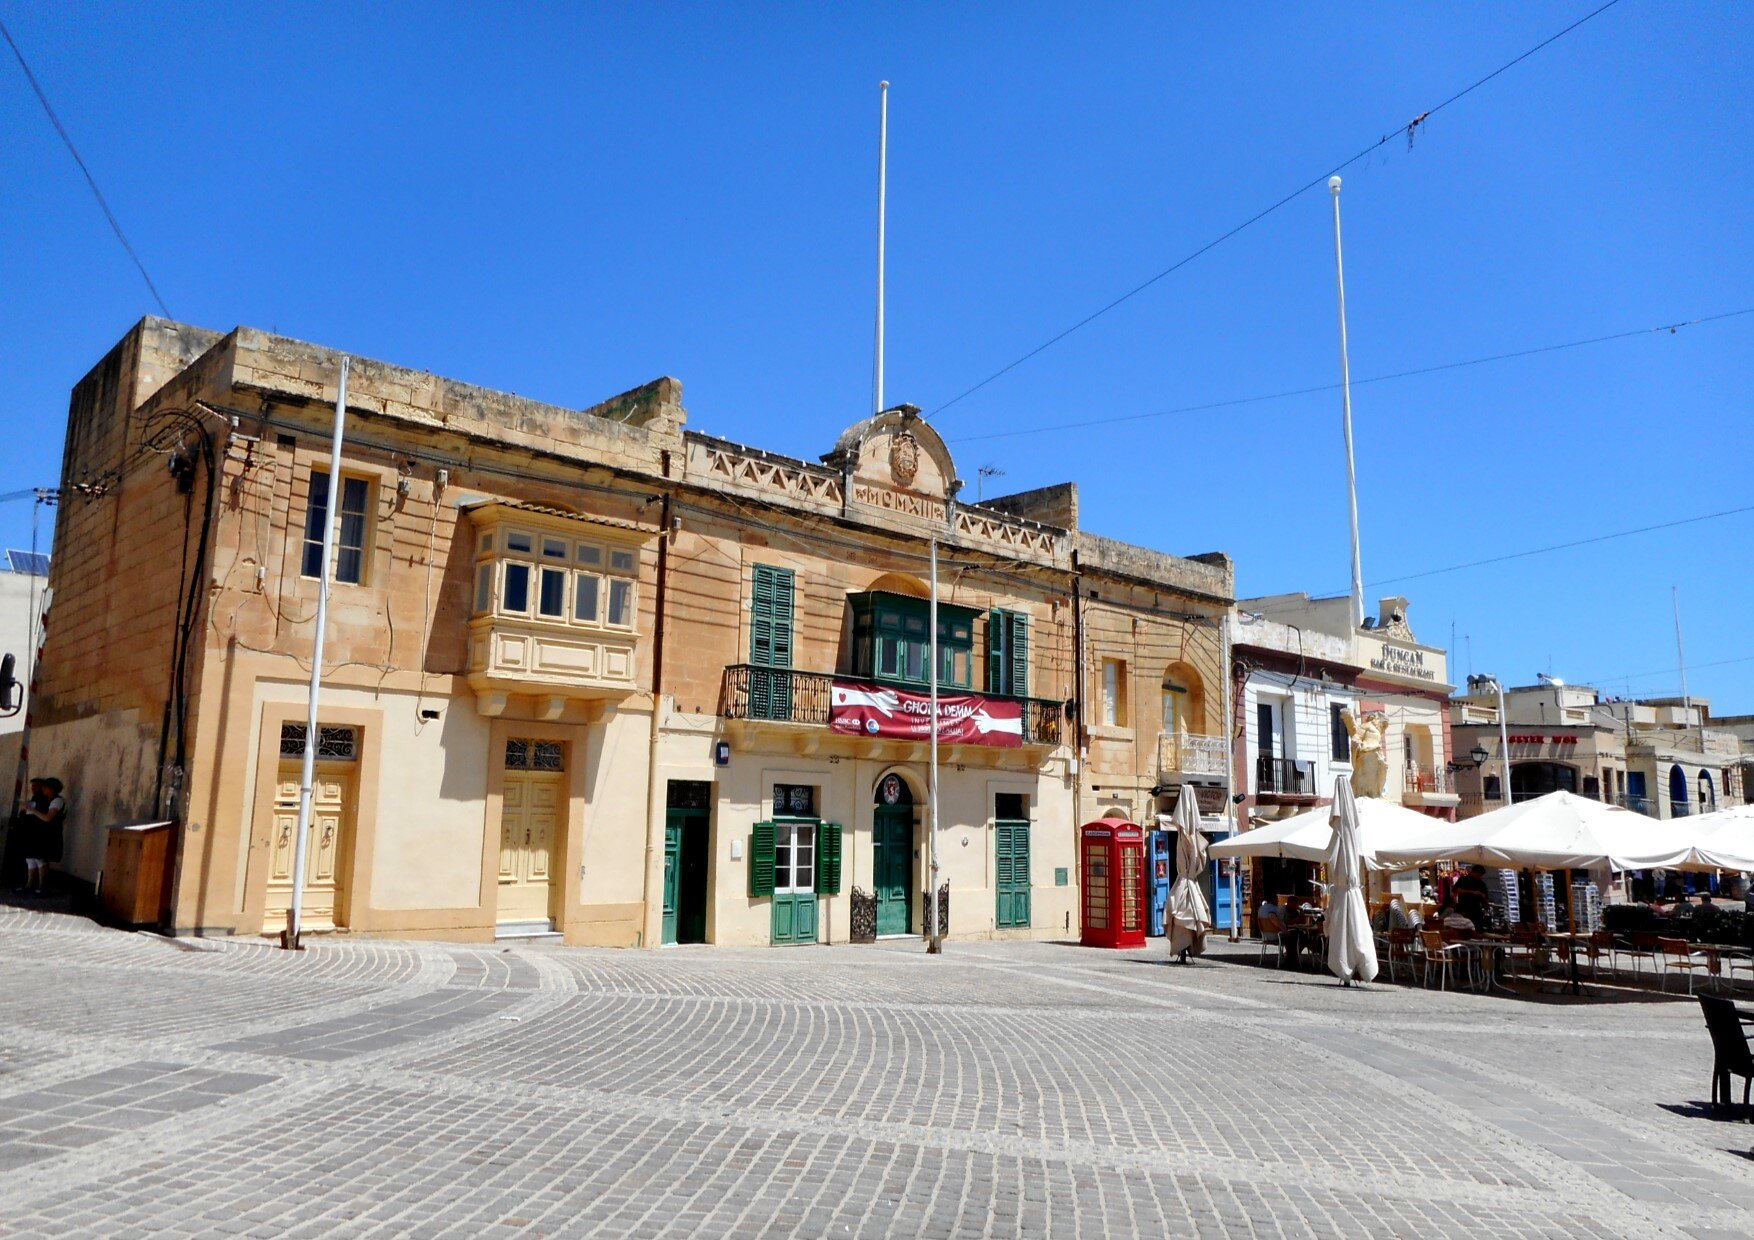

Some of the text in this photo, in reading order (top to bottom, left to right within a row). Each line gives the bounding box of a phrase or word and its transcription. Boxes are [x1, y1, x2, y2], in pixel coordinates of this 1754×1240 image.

[866, 485, 934, 519] MCMXIII
[1370, 658, 1385, 671] BAR
[1393, 663, 1435, 681] RESTAURANT
[1552, 735, 1577, 744] WOK
